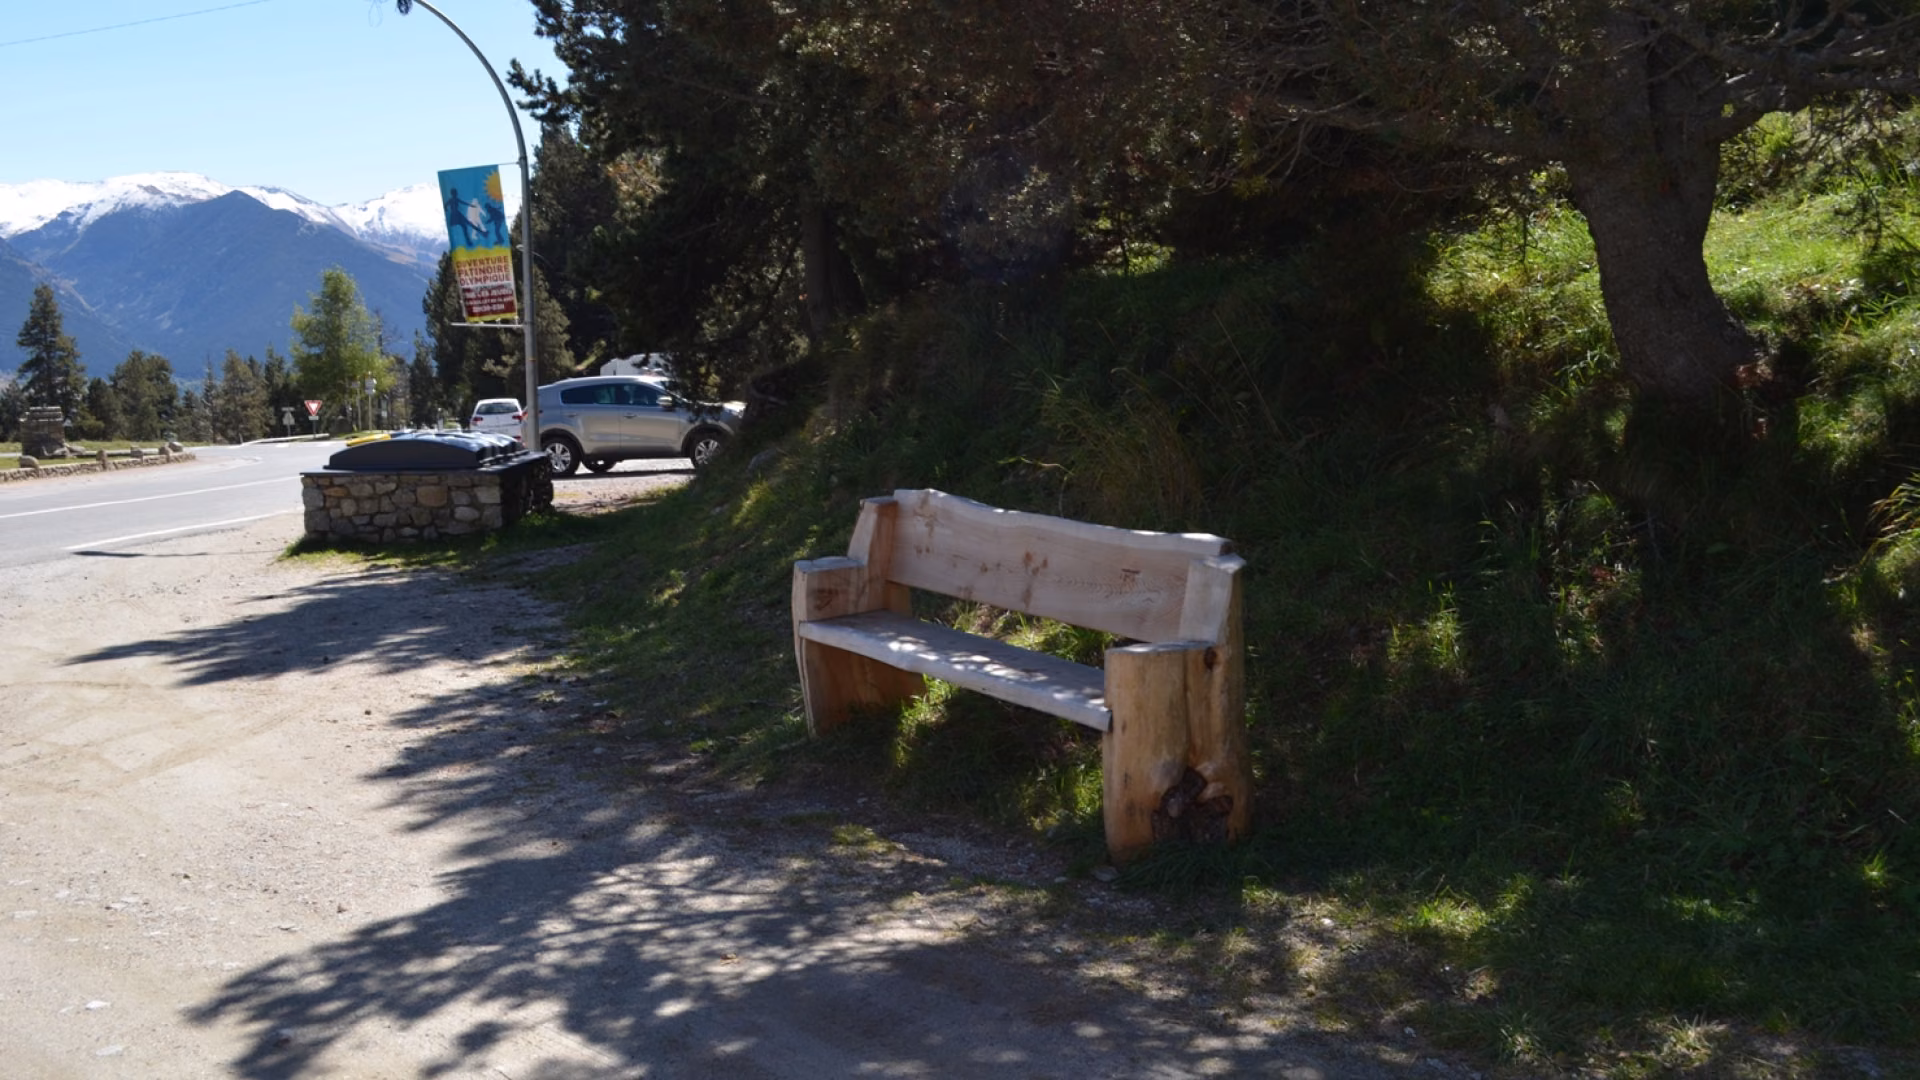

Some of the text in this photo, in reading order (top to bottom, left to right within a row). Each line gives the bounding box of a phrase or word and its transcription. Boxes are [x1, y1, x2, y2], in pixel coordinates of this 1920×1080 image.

[456, 256, 509, 268] OUVERTURE
[458, 264, 510, 277] PATINOIRE
[460, 273, 512, 286] OLYMPIQUE
